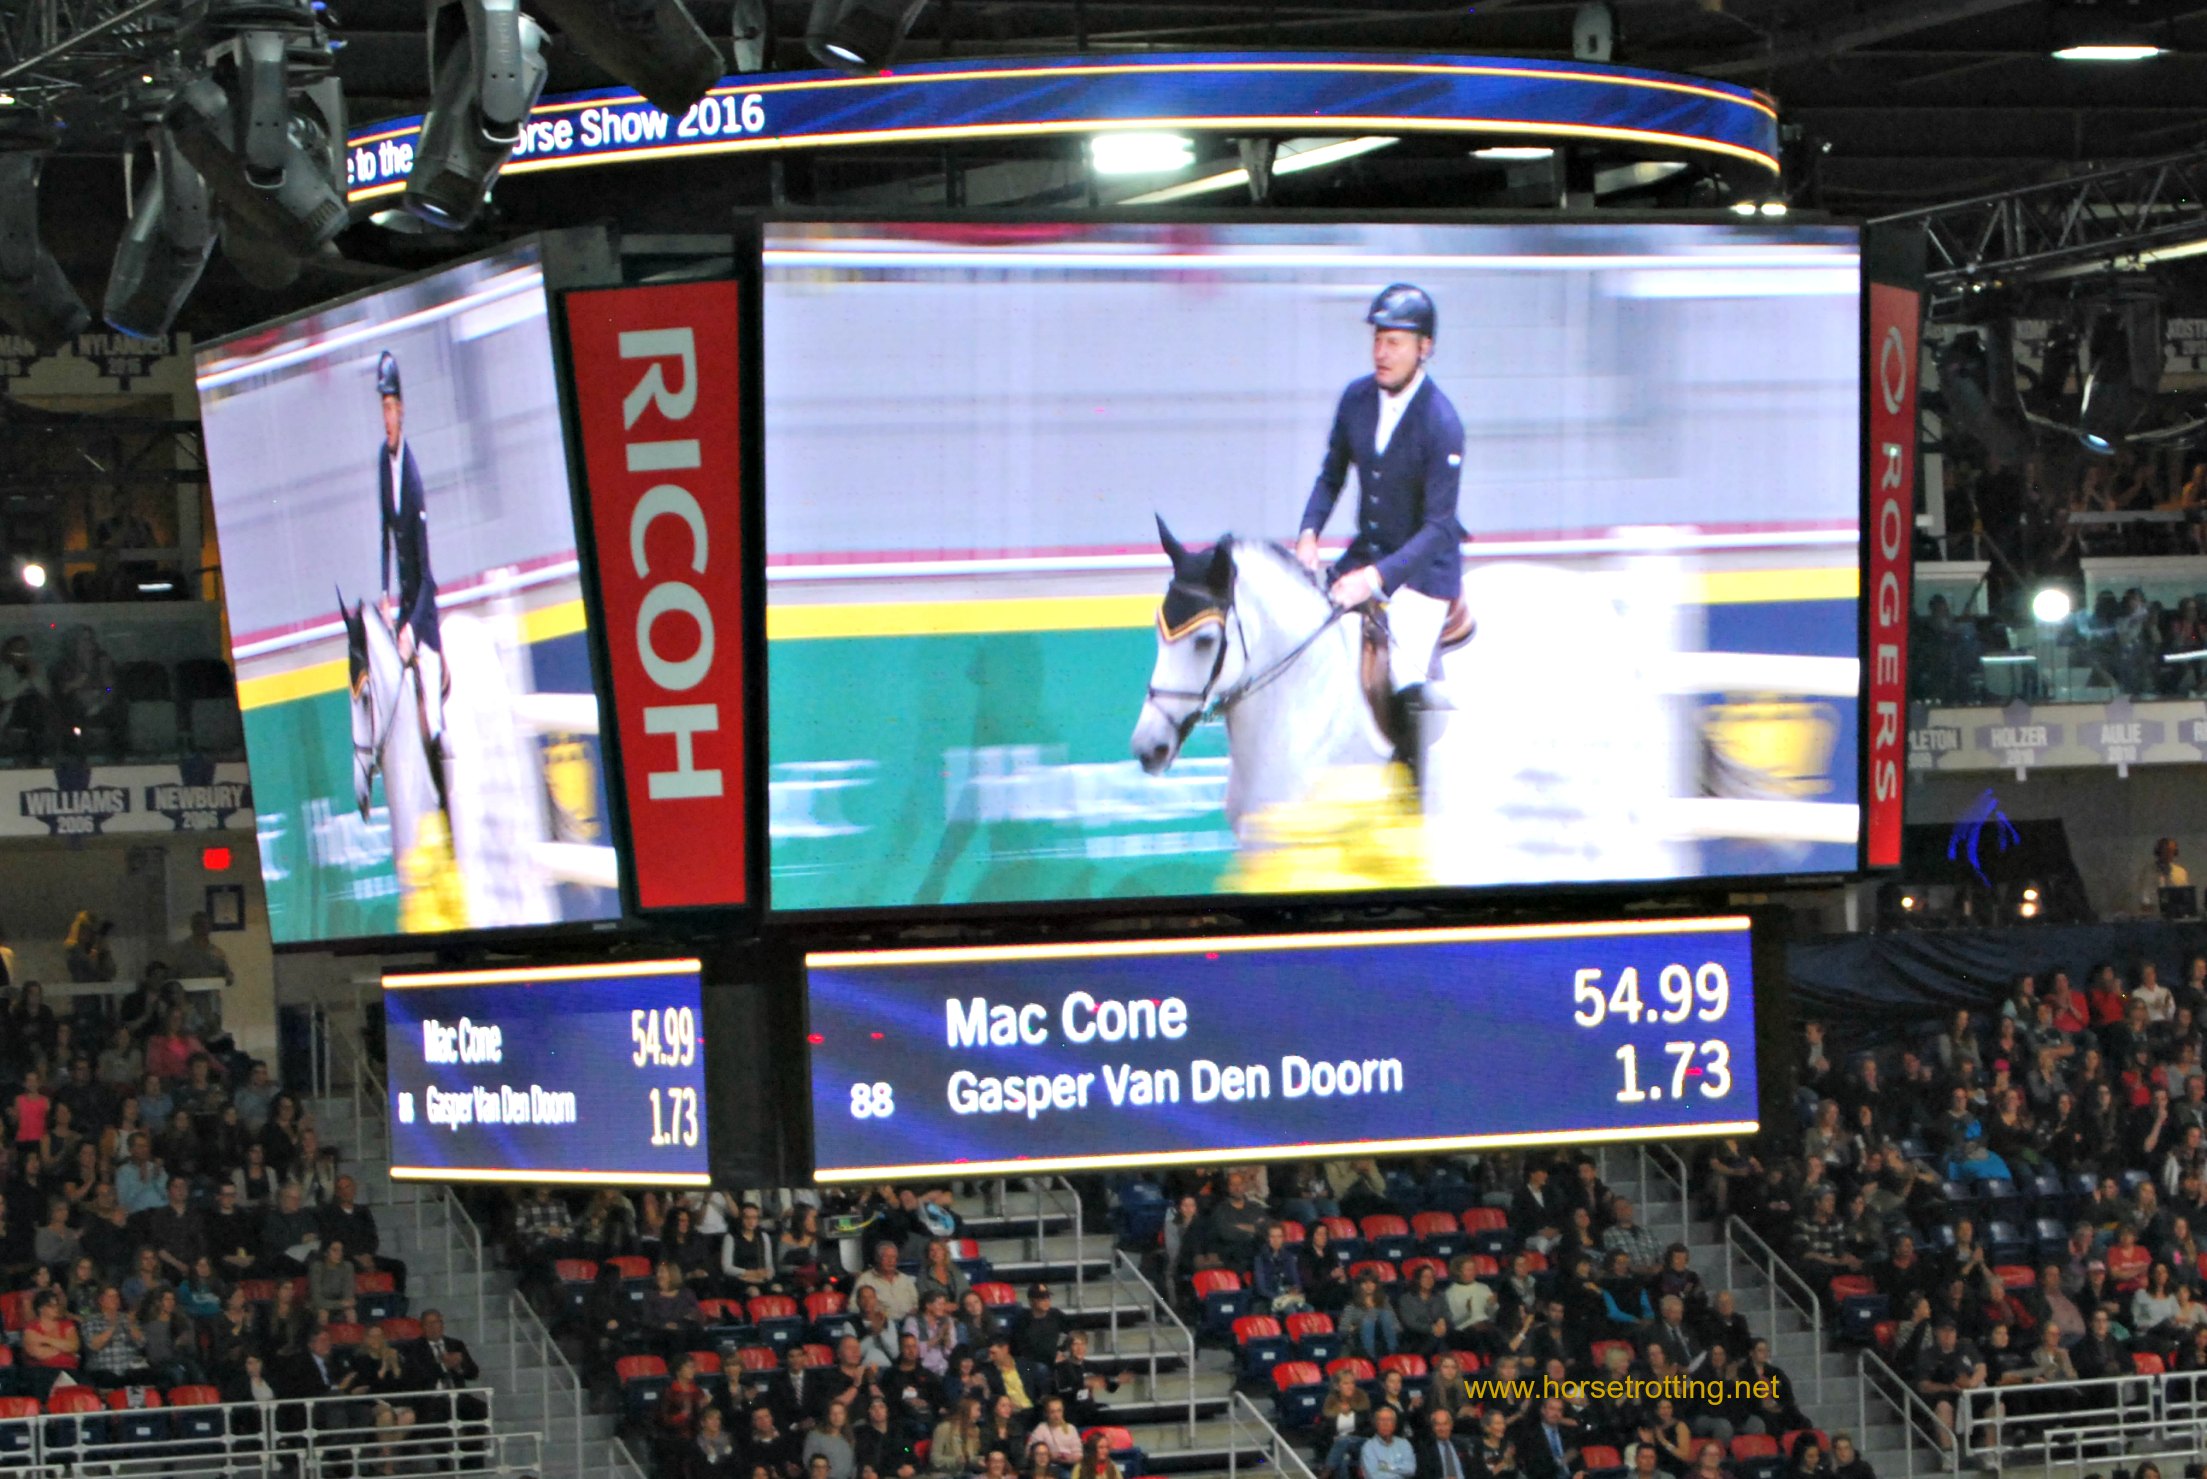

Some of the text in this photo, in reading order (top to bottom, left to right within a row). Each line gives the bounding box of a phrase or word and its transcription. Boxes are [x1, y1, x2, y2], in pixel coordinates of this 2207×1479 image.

[355, 147, 376, 182] to
[378, 139, 414, 177] the
[512, 115, 573, 156] orse
[580, 107, 669, 148] Show
[677, 93, 766, 138] 2016
[617, 326, 724, 801] RICOH
[1874, 442, 1903, 803] ROGERS
[1990, 726, 2049, 749] HOLZER
[2100, 723, 2143, 745] AULIE
[26, 789, 125, 815] WILLIAMS
[154, 785, 244, 811] NEWBURY
[945, 991, 1189, 1048] Mac Cone
[1573, 961, 1730, 1028] 54.99
[422, 1016, 502, 1064] Mac Cone
[631, 1006, 696, 1068] 54.99
[849, 1080, 895, 1120] 88
[947, 1054, 1404, 1121] Gasper Van Den Doorn
[1615, 1039, 1732, 1103] 1.73
[426, 1083, 577, 1132] Gasper Van Den Doorn
[650, 1086, 699, 1147] 1.73
